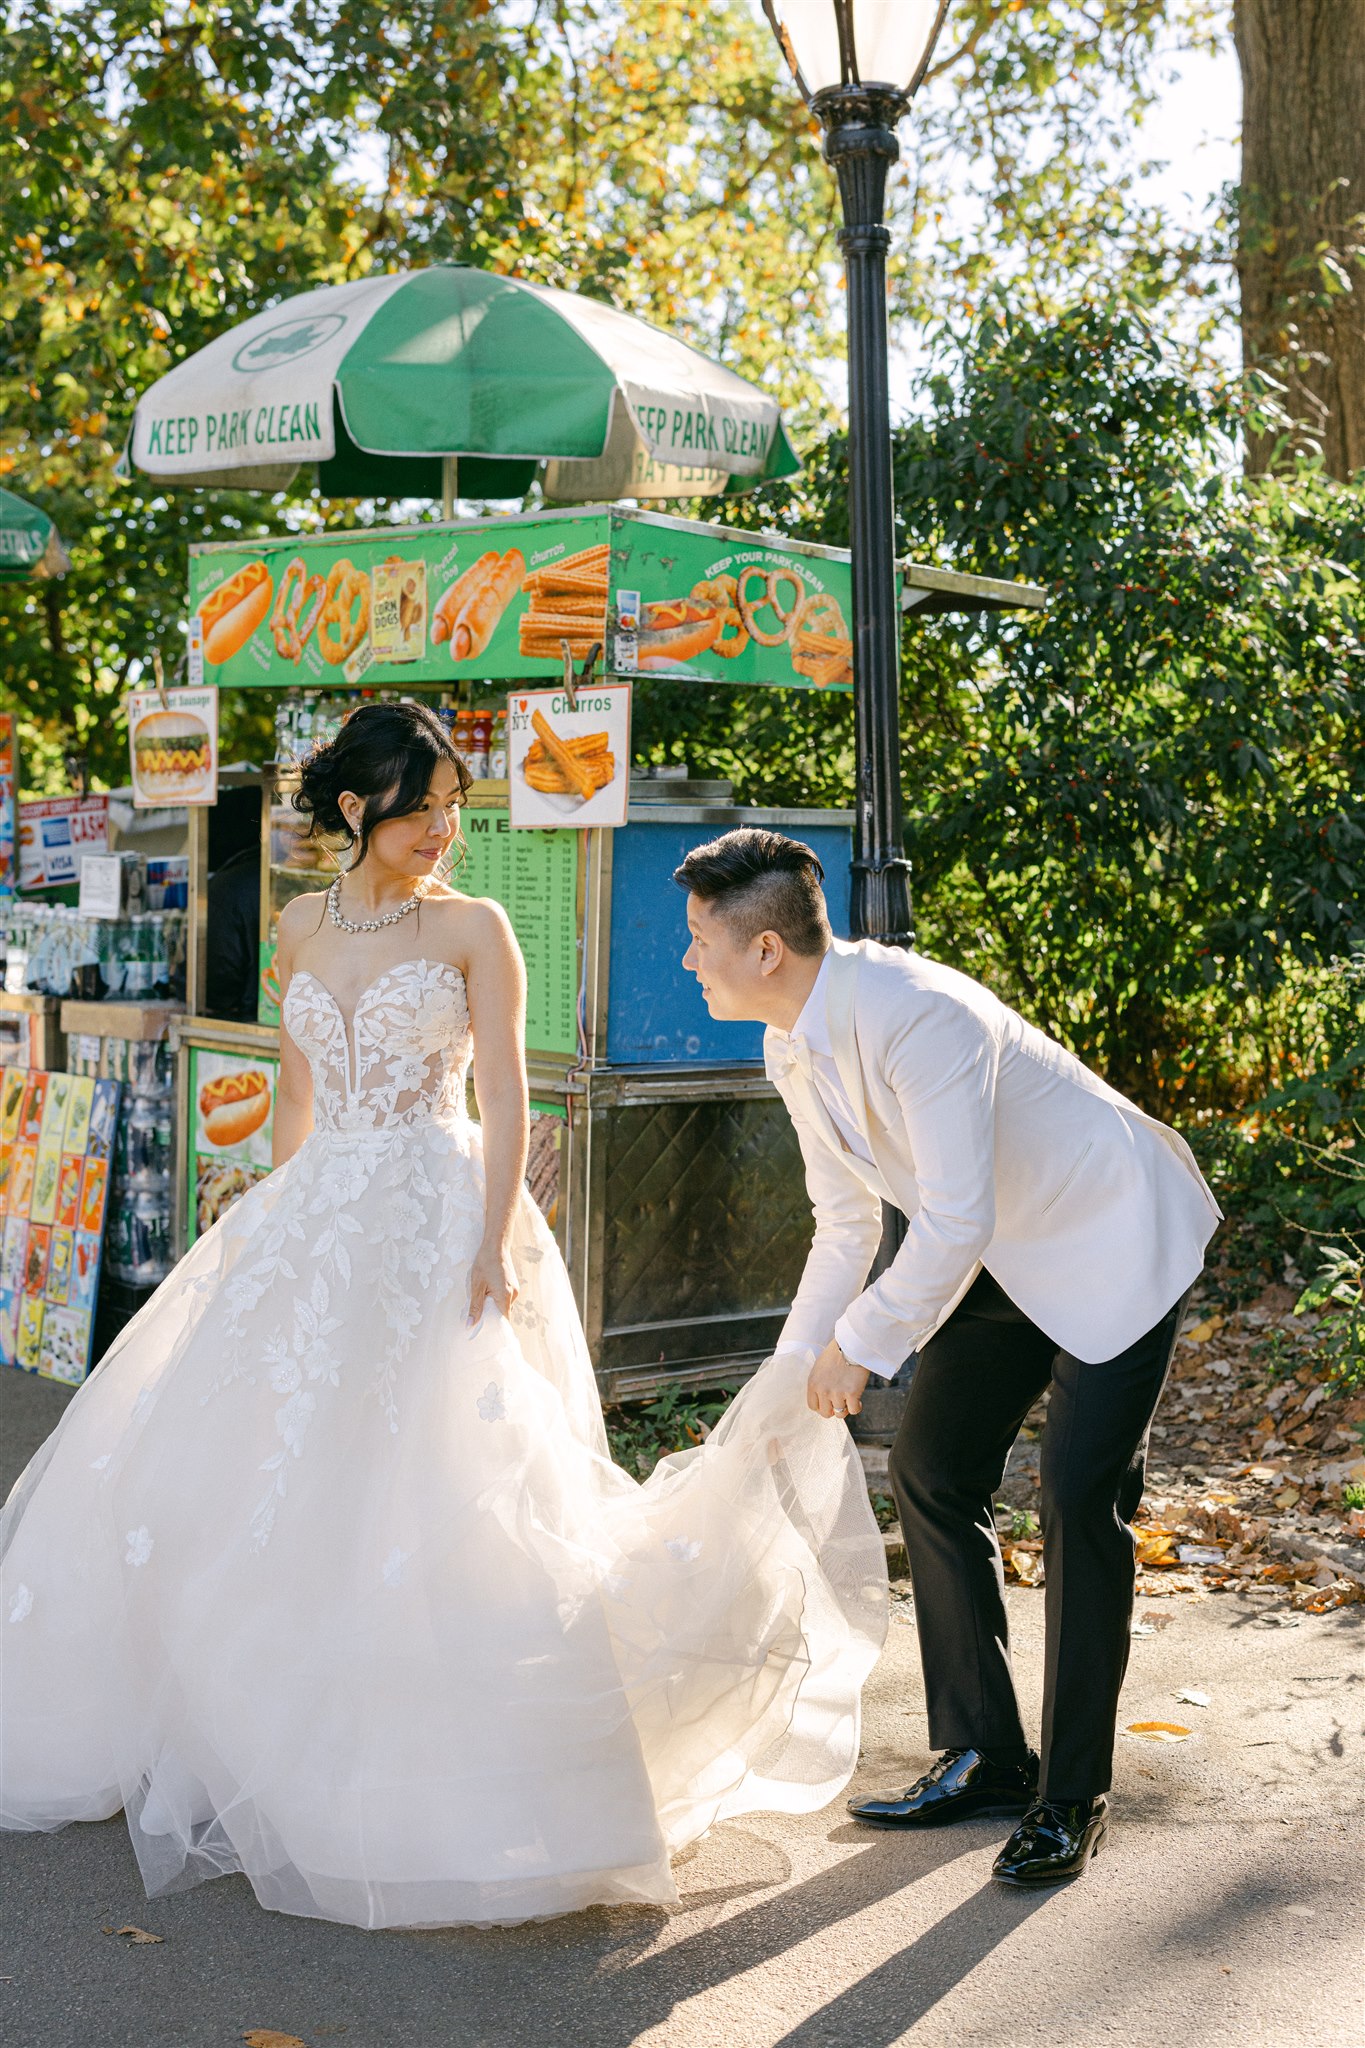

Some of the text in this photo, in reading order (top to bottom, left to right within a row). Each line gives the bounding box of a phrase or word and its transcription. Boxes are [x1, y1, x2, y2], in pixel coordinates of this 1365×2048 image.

[148, 401, 322, 456] KEEP PARK CLEAN
[632, 404, 769, 461] EEP PARK CLEAN
[530, 543, 566, 566] churros
[704, 551, 826, 593] KEEP YOUR PARK CLEAN
[374, 599, 398, 617] CORN
[375, 614, 400, 630] DOGS
[511, 714, 530, 730] NY
[71, 814, 107, 844] CASH
